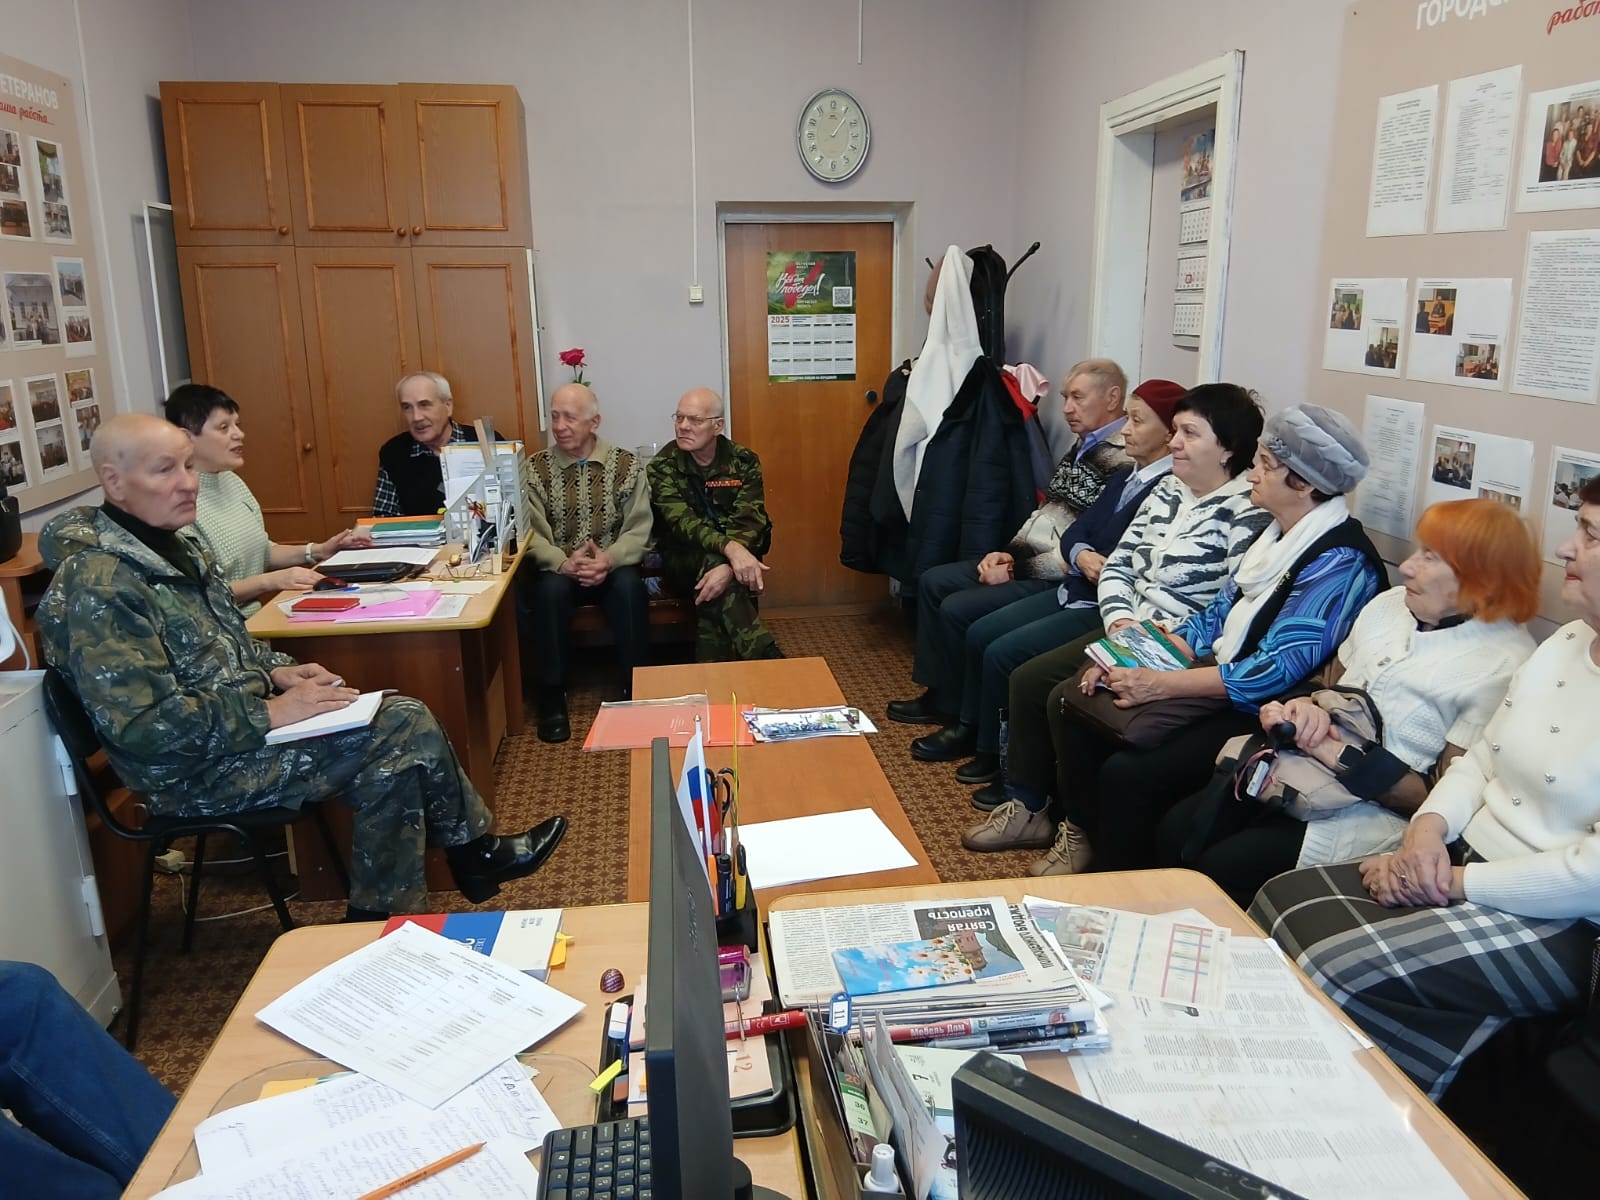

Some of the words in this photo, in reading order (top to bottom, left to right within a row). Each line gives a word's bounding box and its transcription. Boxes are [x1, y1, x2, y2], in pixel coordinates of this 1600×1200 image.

[770, 316, 790, 324] 2025
[927, 907, 992, 920] крепость
[948, 920, 996, 932] Святая
[909, 1025, 945, 1037] Мебель
[947, 1023, 966, 1034] Дом
[857, 1116, 869, 1126] 37
